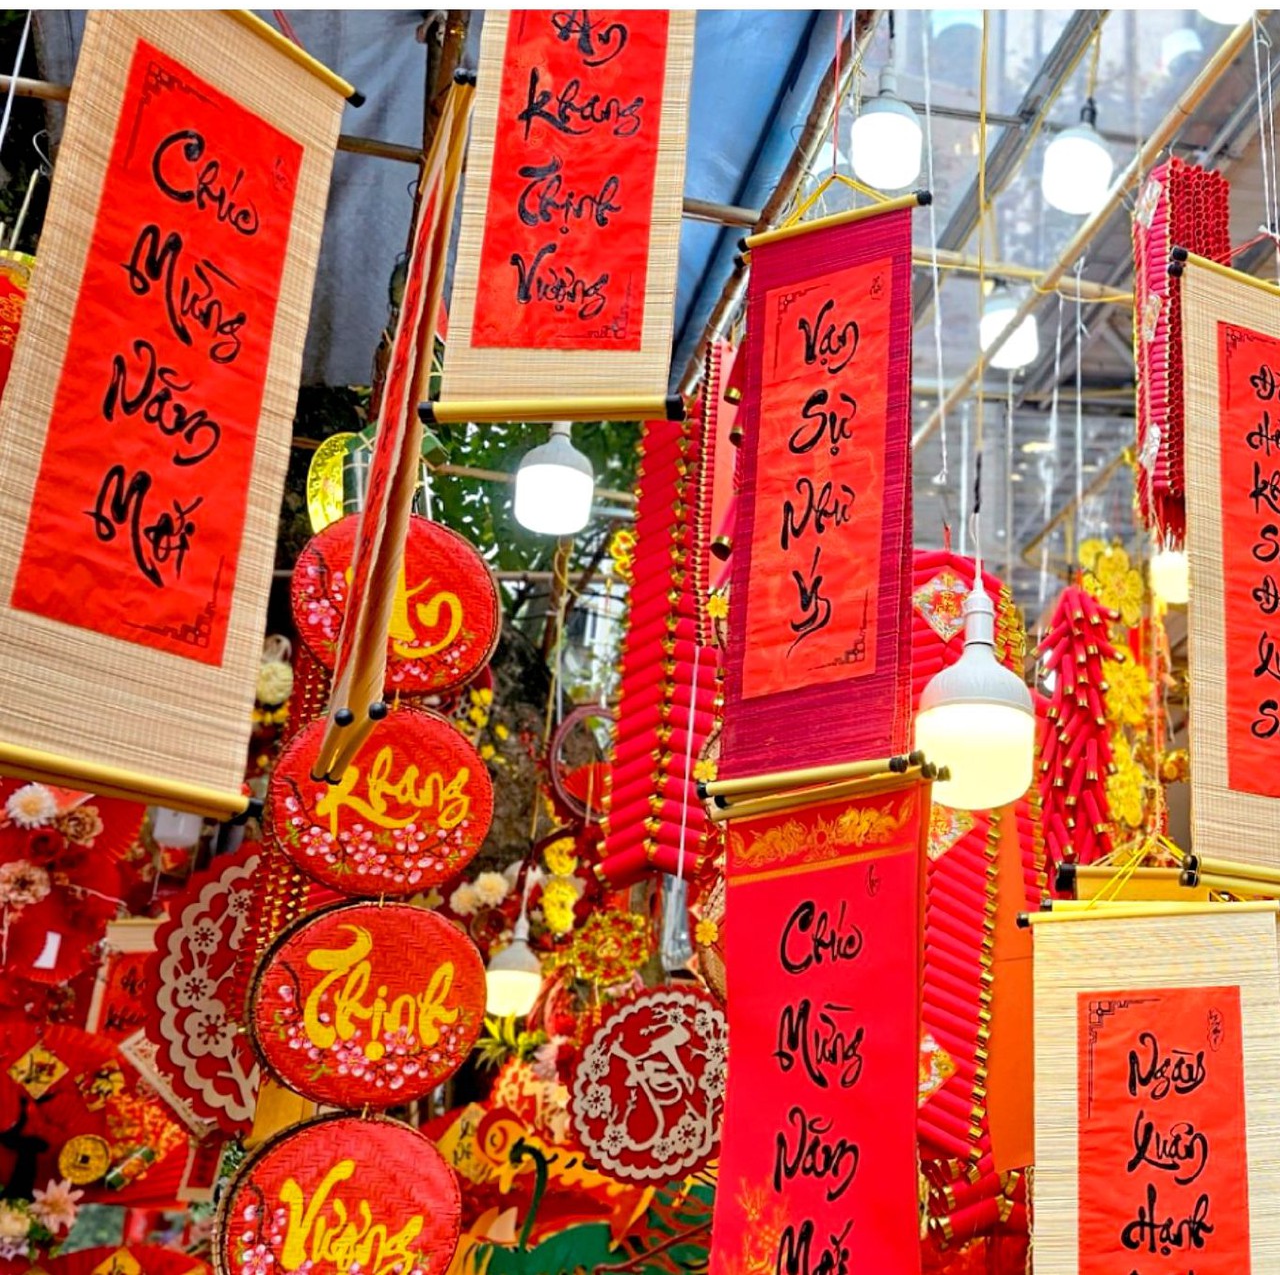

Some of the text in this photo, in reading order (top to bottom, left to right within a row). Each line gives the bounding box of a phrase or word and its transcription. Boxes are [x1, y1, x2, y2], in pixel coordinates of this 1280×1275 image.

[517, 66, 645, 141] Khang
[152, 130, 259, 236] Chúc
[517, 156, 622, 234] Thịnh
[120, 224, 247, 364] Mừng
[510, 243, 610, 321] Vượng
[798, 299, 860, 375] Vạn
[103, 338, 222, 467] Năm
[788, 390, 857, 457] Sự
[82, 463, 203, 587] Mới
[781, 478, 856, 551] Như
[787, 546, 832, 658] Ý
[315, 745, 471, 841] Khang
[779, 900, 863, 975] Chúc
[306, 924, 459, 1062] Thịnh
[771, 999, 865, 1089] Mừng
[1127, 1031, 1207, 1101] Ngày
[773, 1105, 860, 1203] Năm
[1127, 1109, 1209, 1187] Xuân
[279, 1158, 425, 1274] Vượng
[1121, 1183, 1215, 1257] Hạnh
